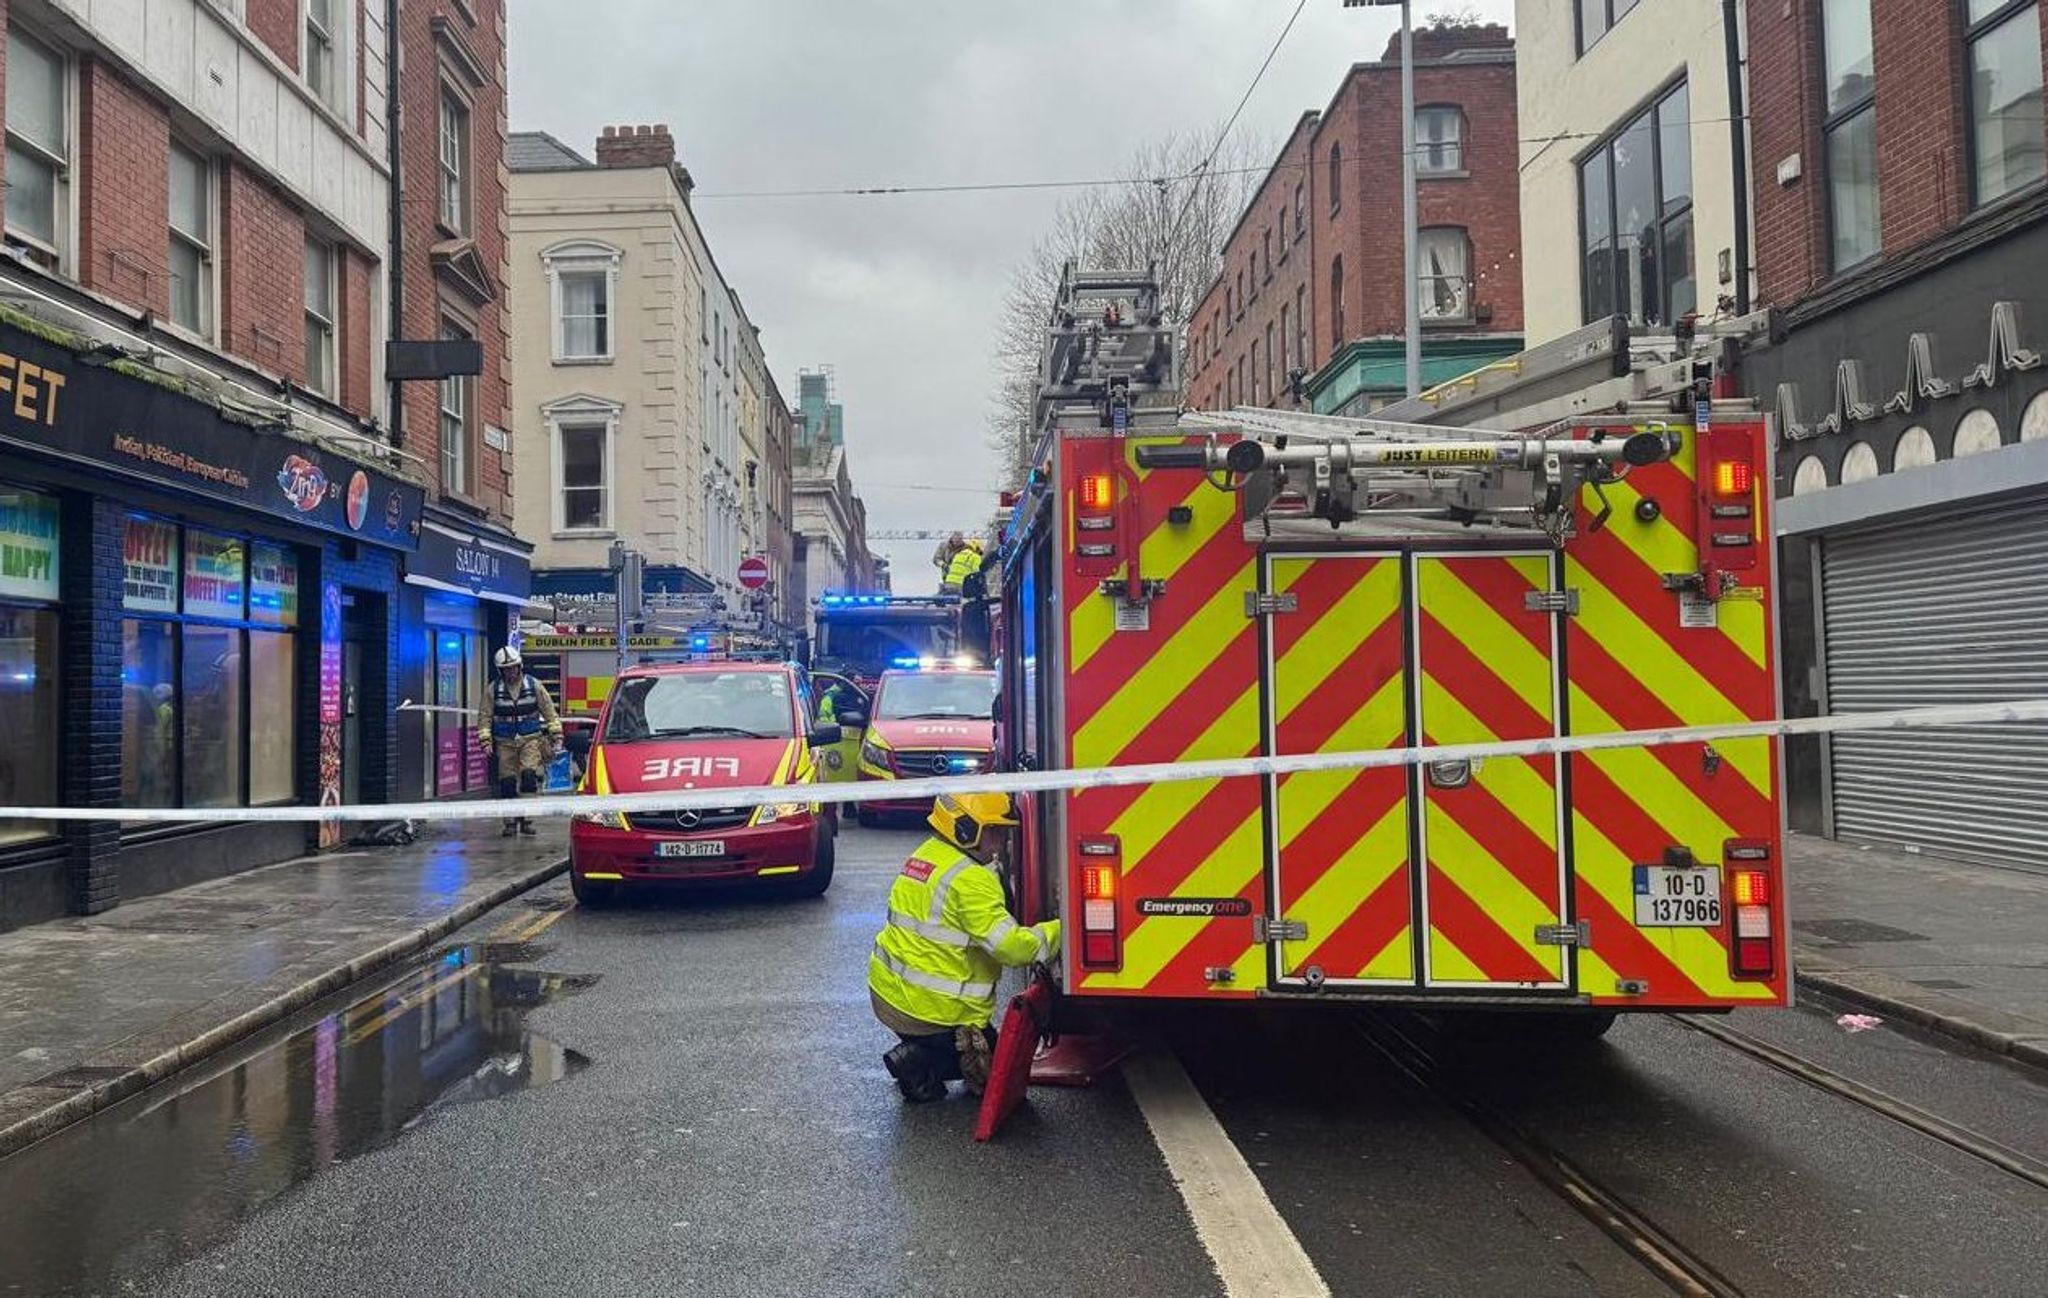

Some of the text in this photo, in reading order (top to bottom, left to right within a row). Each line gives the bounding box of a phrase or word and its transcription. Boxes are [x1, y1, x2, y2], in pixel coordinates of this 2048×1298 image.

[1382, 449, 1422, 461] JUST
[1427, 448, 1490, 461] LEITERN
[3, 543, 52, 581] HAPPY
[455, 547, 500, 579] SALON 14
[554, 592, 595, 603] Street
[535, 637, 661, 647] DUBLIN FIRE BIGADE
[665, 842, 721, 855] 142-D-11774
[1665, 874, 1705, 896] 10-D
[1652, 898, 1720, 922] 137966
